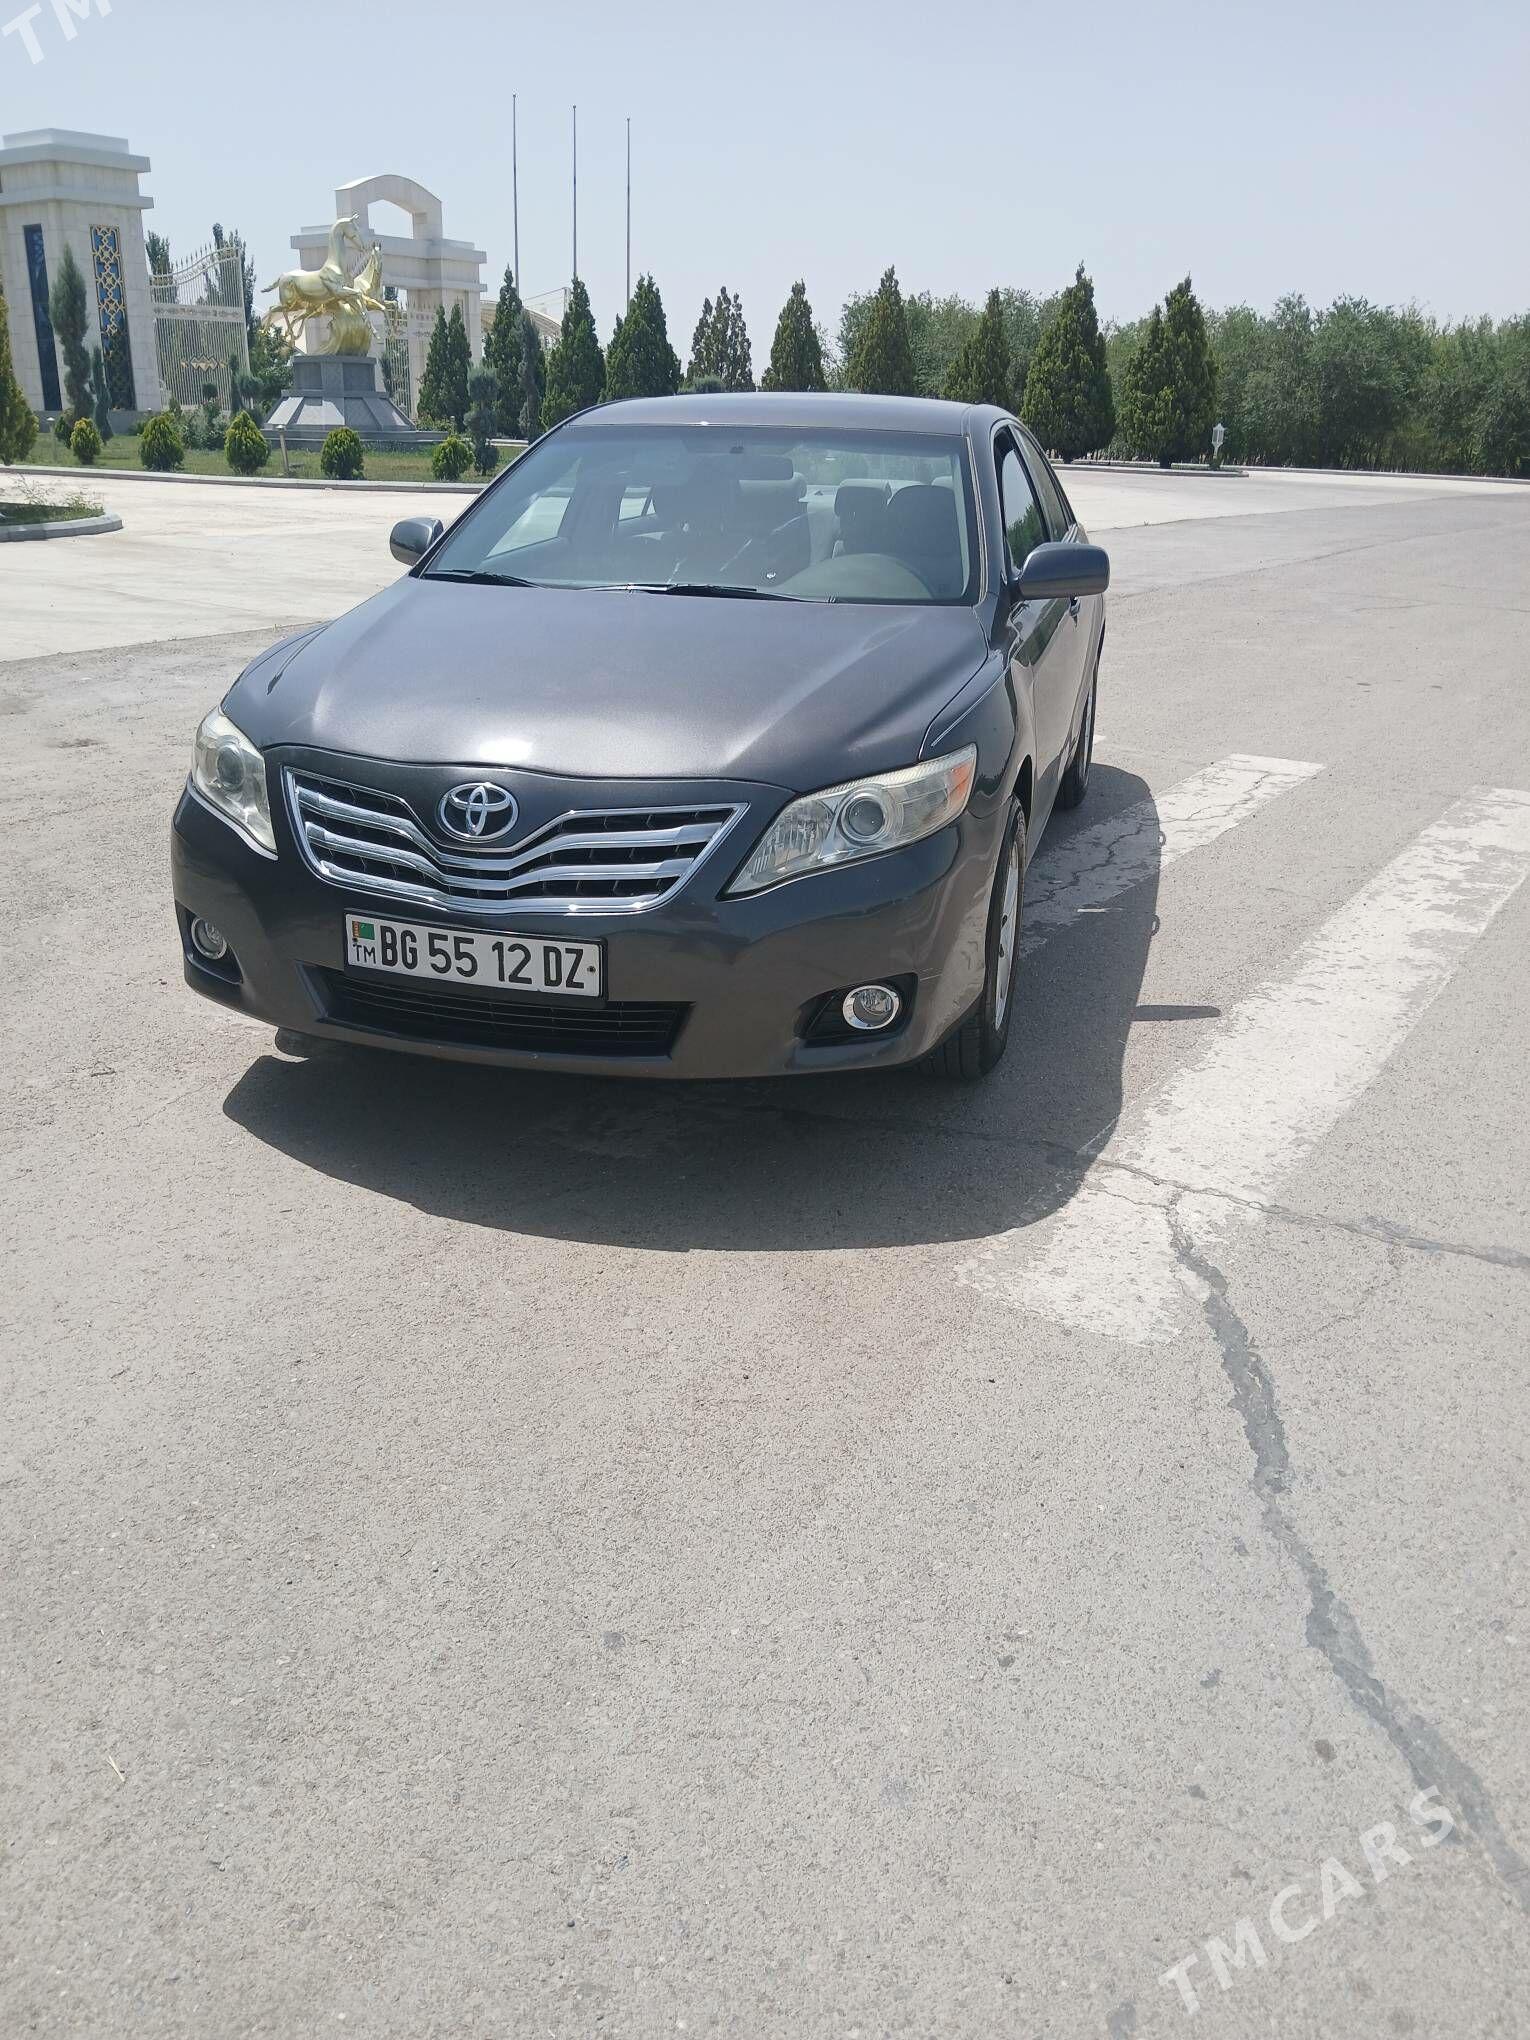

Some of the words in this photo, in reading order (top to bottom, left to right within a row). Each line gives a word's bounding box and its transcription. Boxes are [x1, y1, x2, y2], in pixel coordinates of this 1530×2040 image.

[353, 944, 376, 964] TM
[380, 925, 418, 969] BG
[428, 932, 478, 977] 55
[492, 942, 533, 985] 12
[544, 946, 585, 989] DZ
